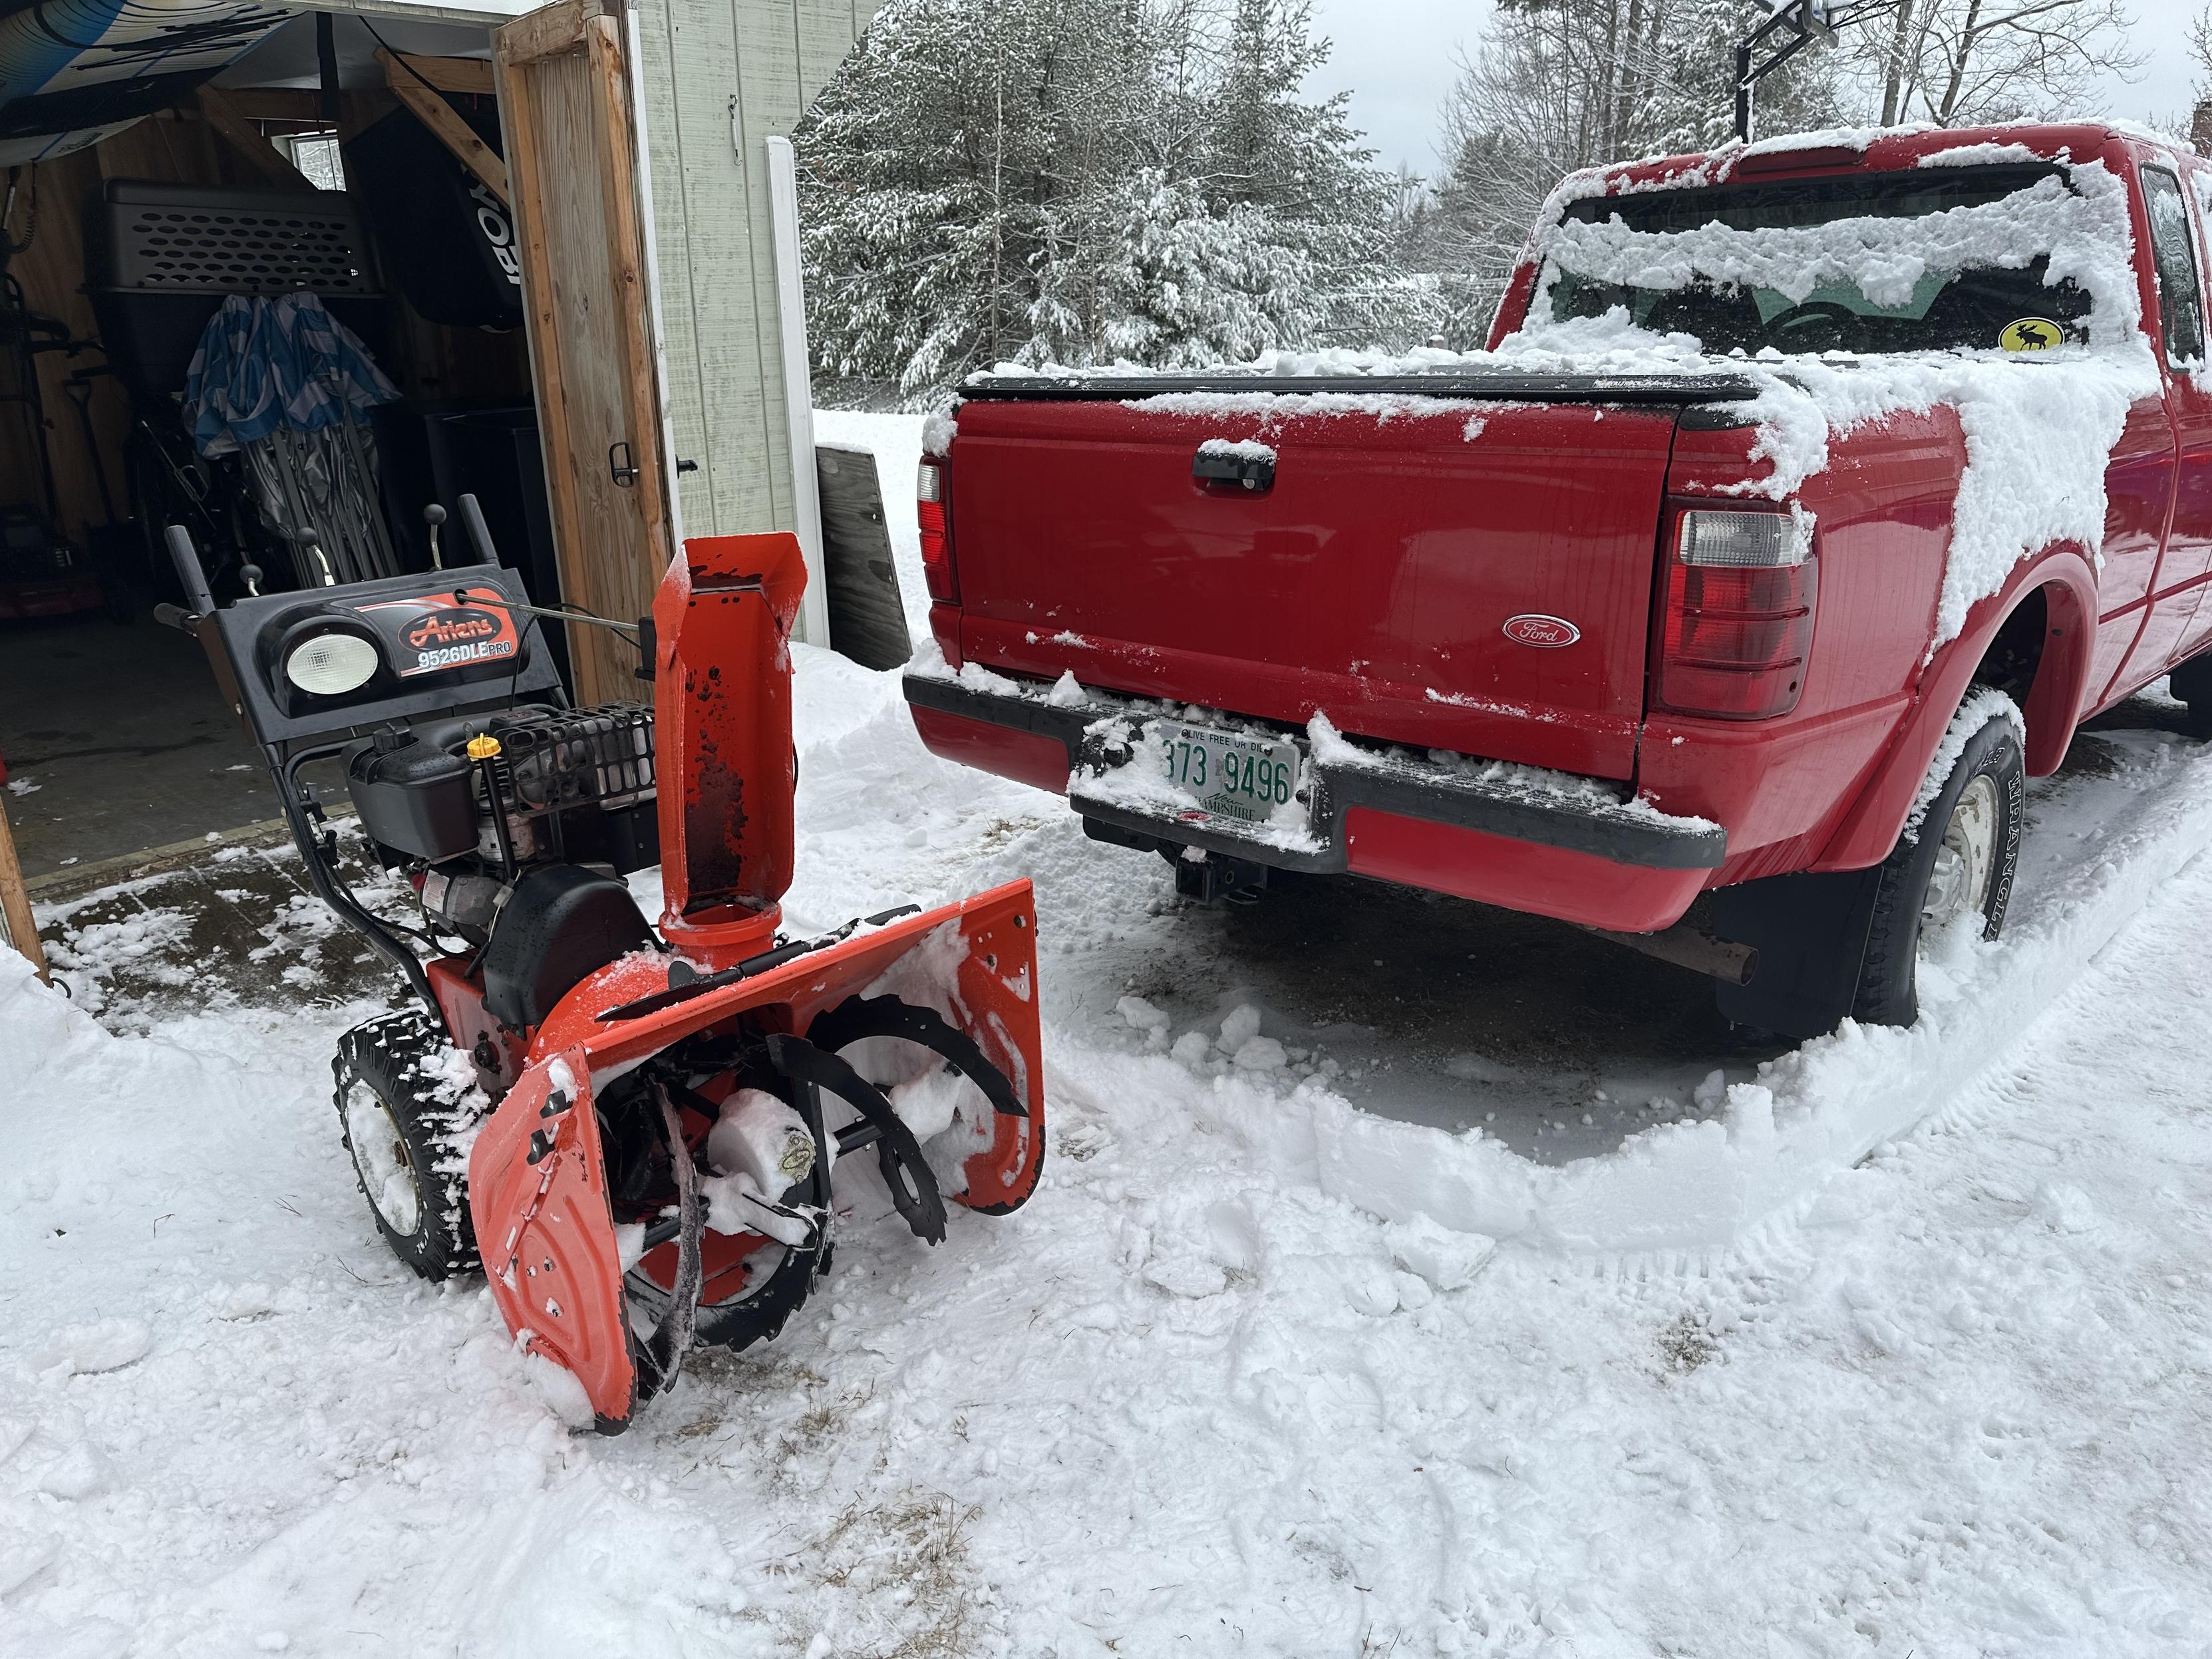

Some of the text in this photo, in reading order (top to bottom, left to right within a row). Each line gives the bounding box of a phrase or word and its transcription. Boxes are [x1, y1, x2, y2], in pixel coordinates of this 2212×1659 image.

[460, 164, 521, 285] YOBI
[409, 616, 493, 647] Ariens
[1519, 622, 1559, 642] Ford
[1187, 730, 1205, 741] LIVE
[1209, 733, 1230, 746] FREE
[1234, 740, 1247, 750] OR
[1224, 752, 1289, 805] 9496
[1205, 792, 1243, 806] New
[1985, 771, 2022, 942] WRANGLE
